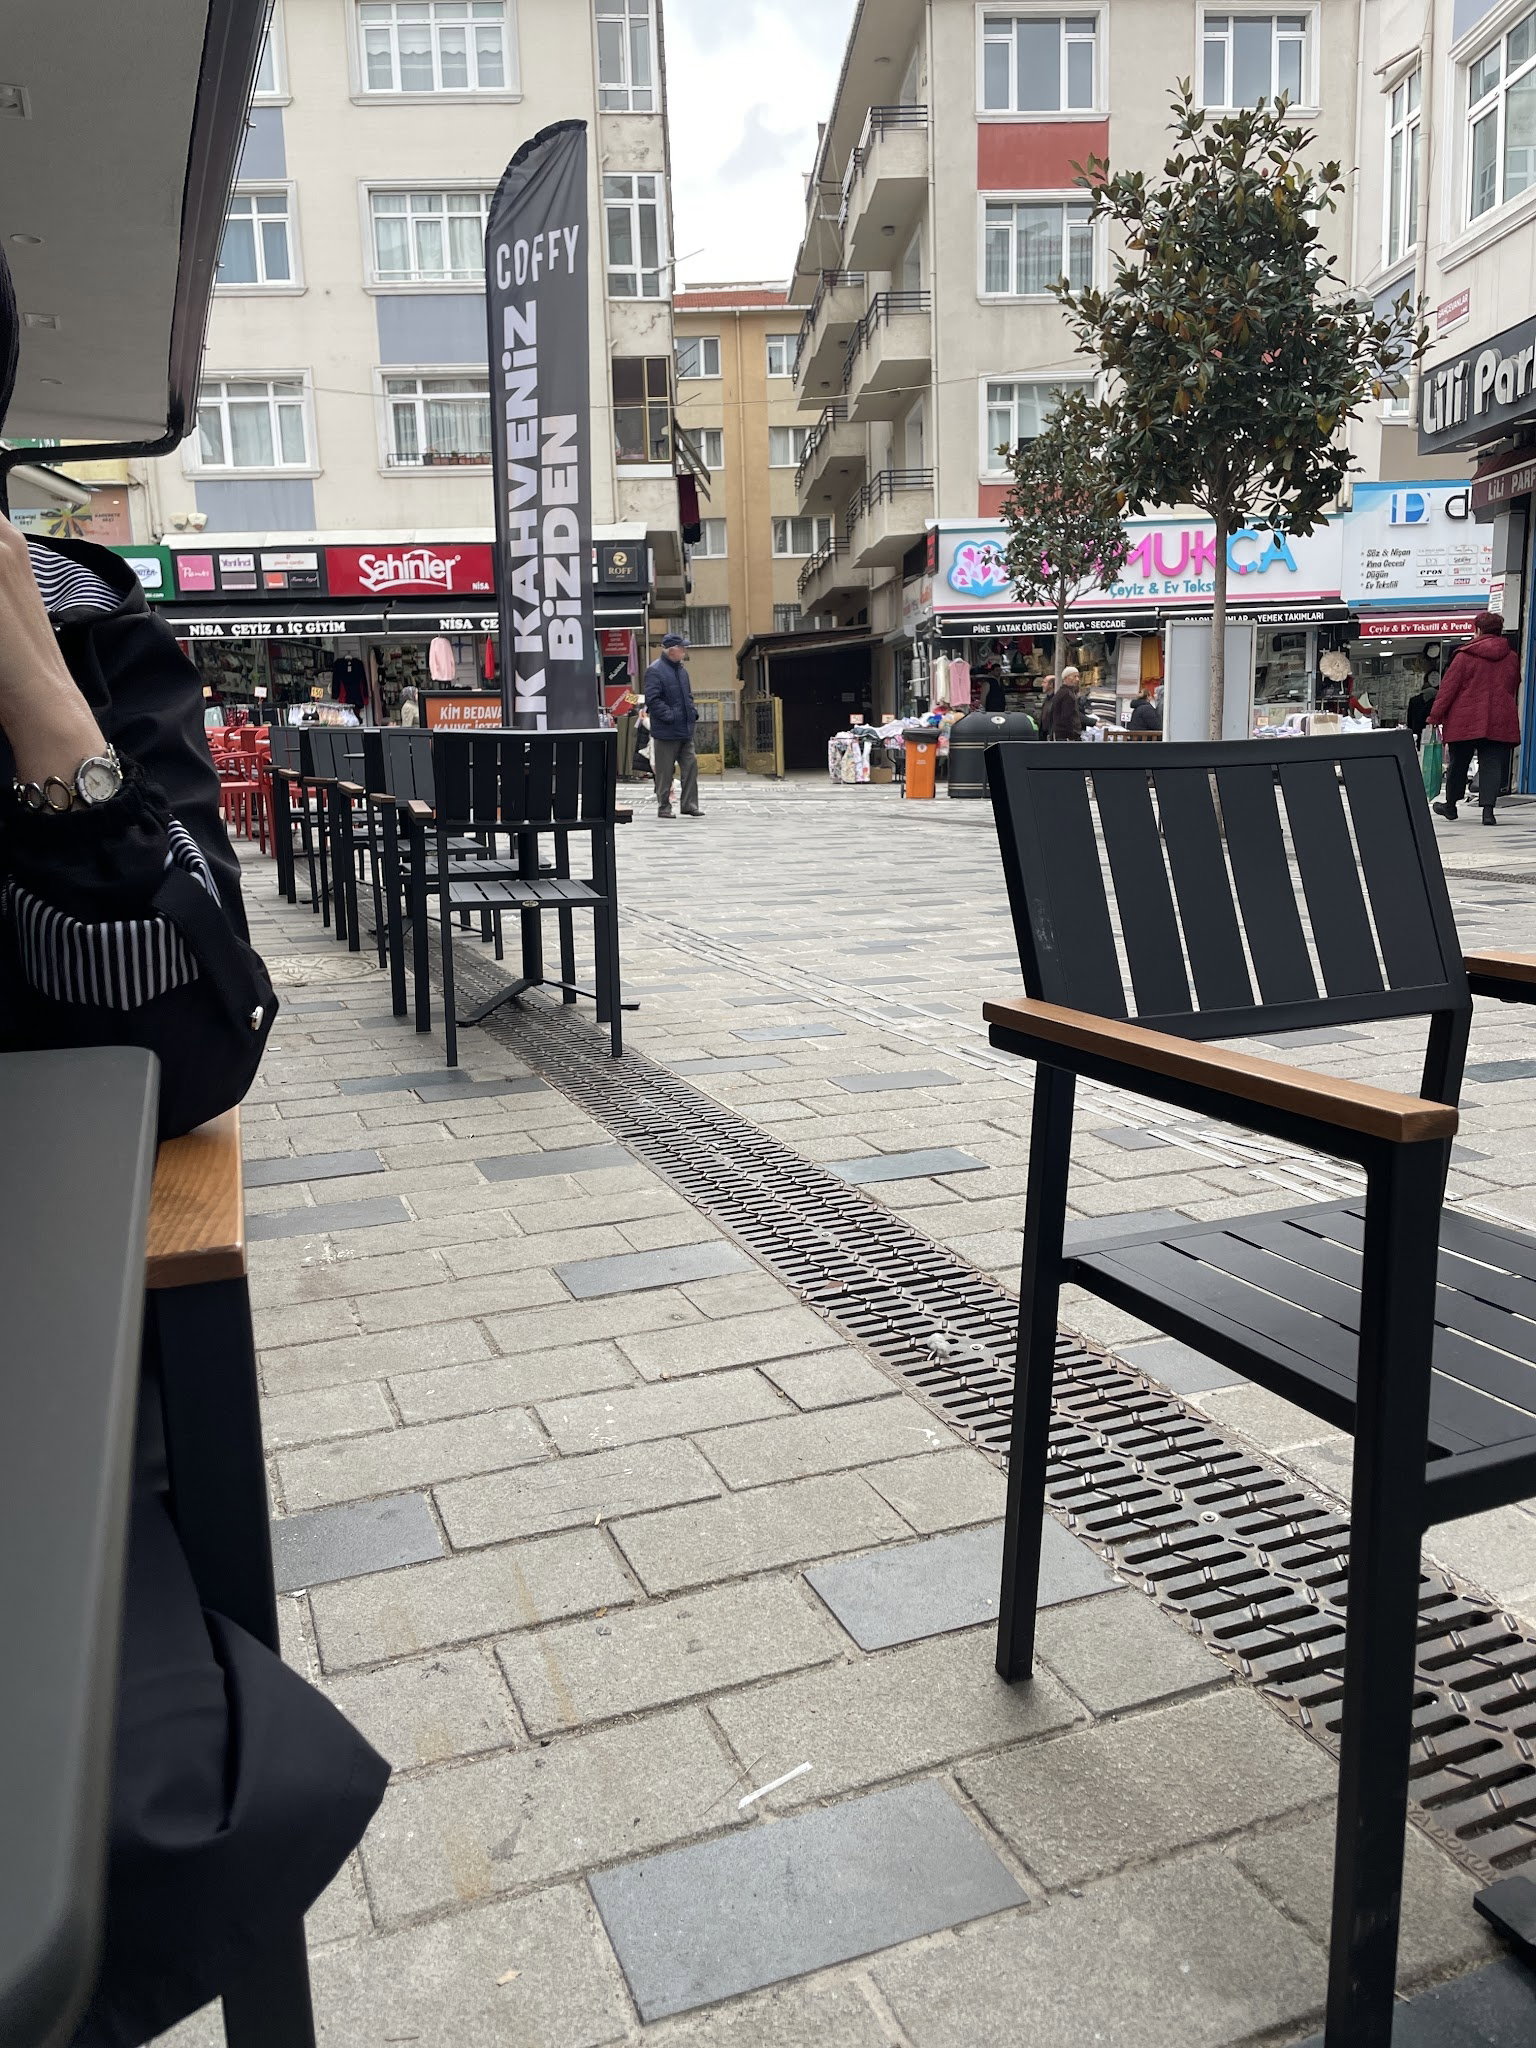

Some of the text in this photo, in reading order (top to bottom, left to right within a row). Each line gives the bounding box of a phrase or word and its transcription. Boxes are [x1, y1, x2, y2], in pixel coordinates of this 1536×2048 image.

[497, 225, 579, 290] COFFY
[608, 567, 633, 575] ROFF
[1149, 582, 1159, 594] &
[1164, 580, 1179, 594] Ev
[1184, 579, 1217, 593] Tekst
[1257, 614, 1283, 623] YEMEK
[1284, 612, 1325, 622] TAKIMLARI
[189, 620, 346, 637] NİSA ÇEYİZ & İÇ GİYİM
[439, 618, 499, 633] NİSA ÇE
[996, 625, 1022, 633] YATAK
[1022, 622, 1051, 632] ÖRTÜSÜ
[1063, 621, 1085, 631] OHÇA
[1091, 619, 1127, 630] SECCADE
[1368, 622, 1472, 634] Çeyiz & Ev Tekstili & Perde
[440, 703, 461, 720] KİM
